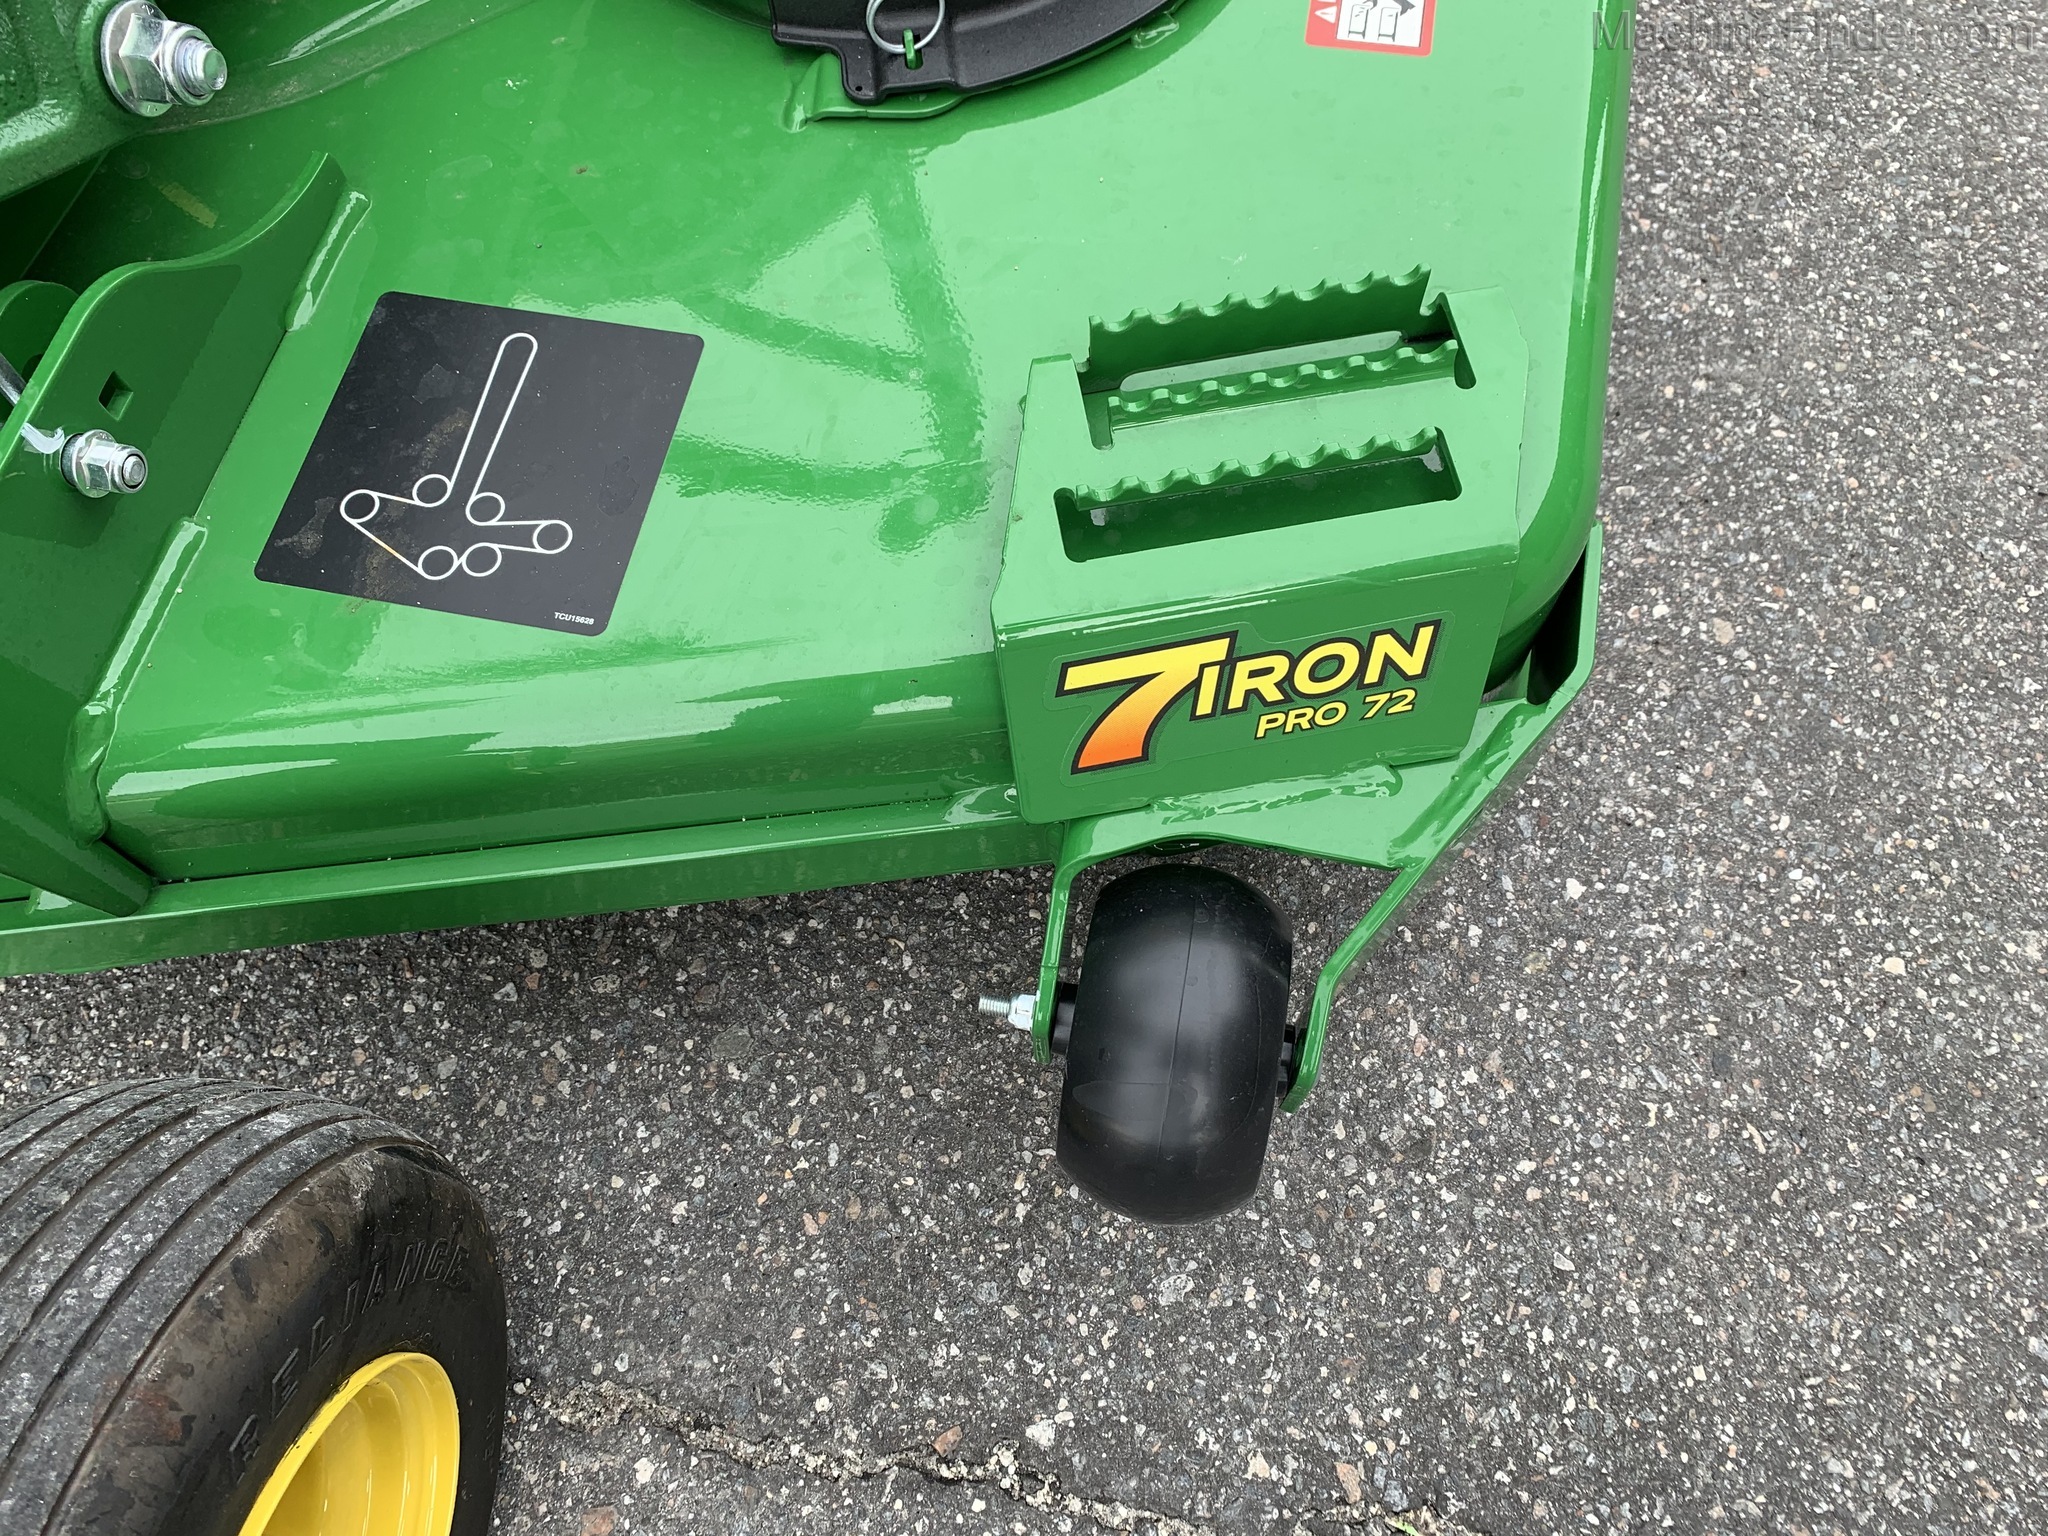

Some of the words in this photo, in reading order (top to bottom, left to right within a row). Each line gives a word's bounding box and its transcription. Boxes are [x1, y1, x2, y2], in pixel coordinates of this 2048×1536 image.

[1254, 701, 1348, 740] PRO
[1359, 688, 1418, 722] 72
[229, 1237, 470, 1485] RELIANCE
